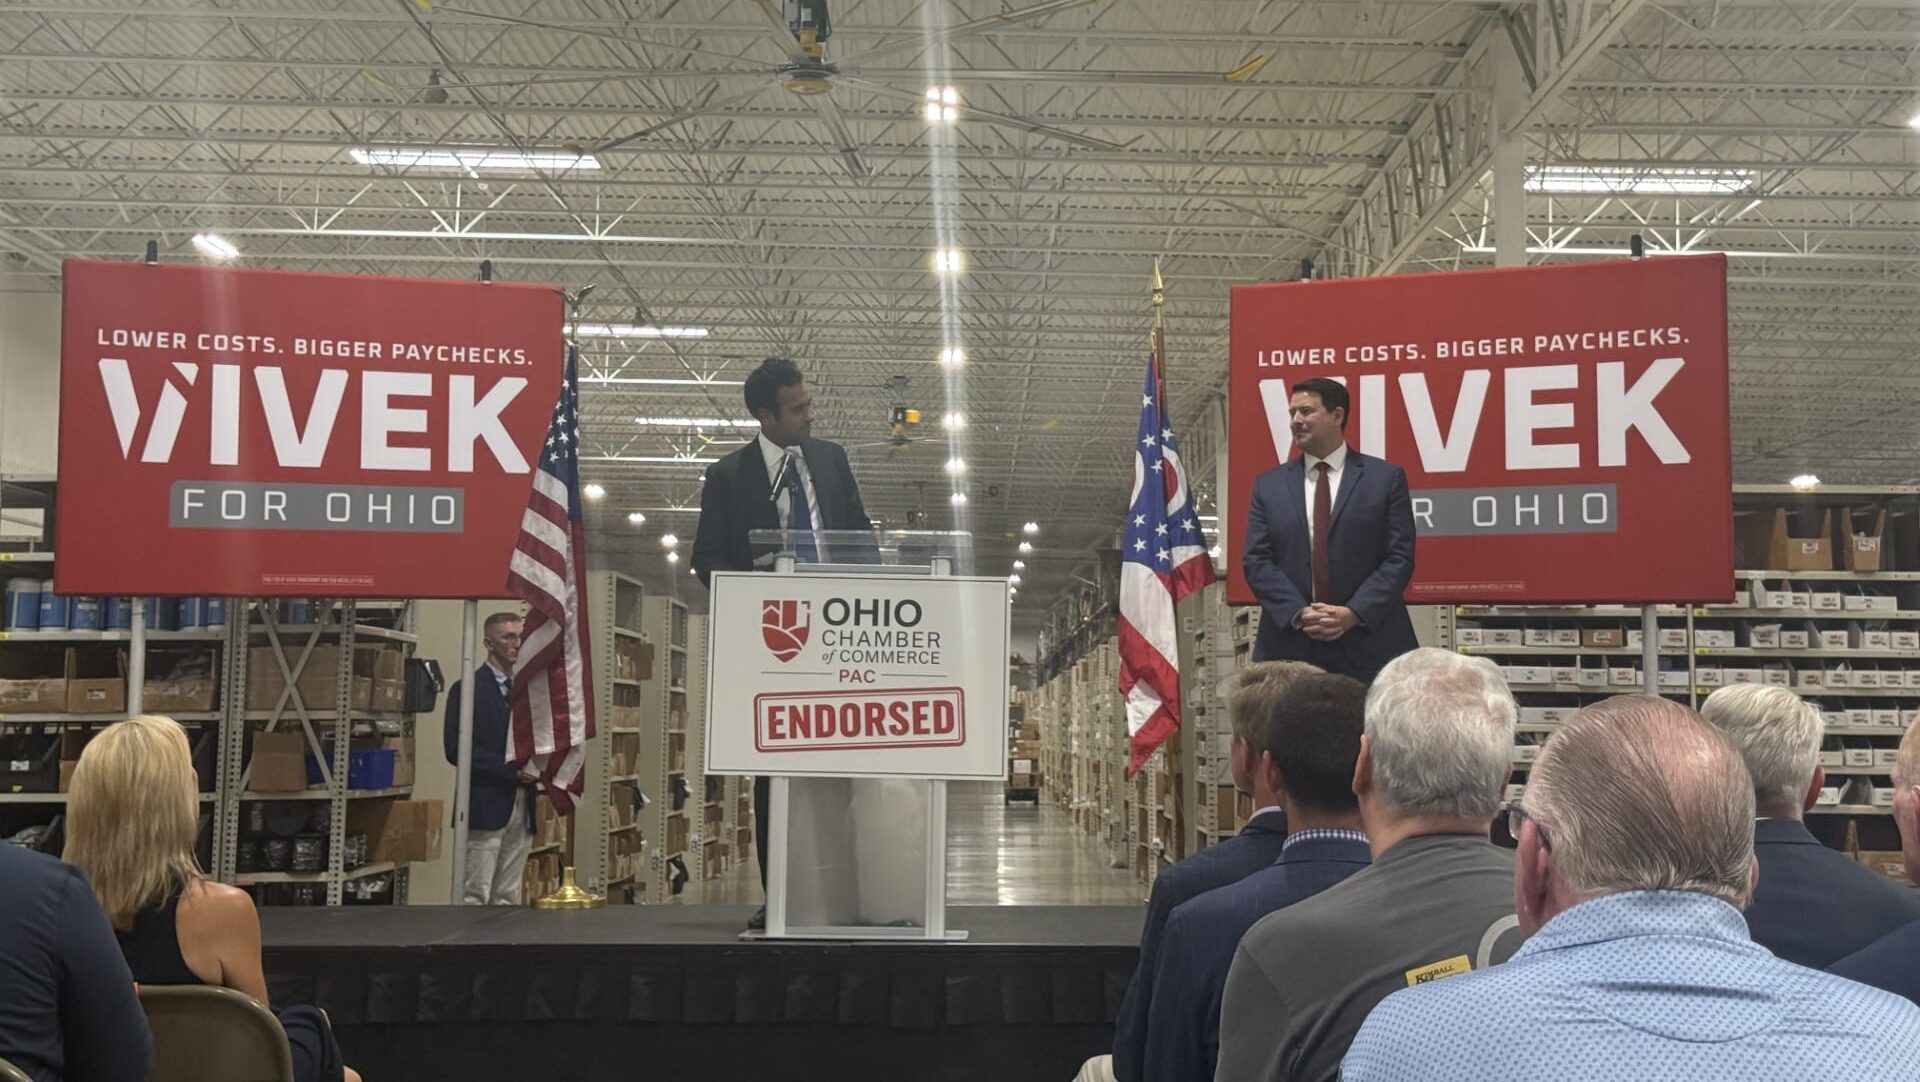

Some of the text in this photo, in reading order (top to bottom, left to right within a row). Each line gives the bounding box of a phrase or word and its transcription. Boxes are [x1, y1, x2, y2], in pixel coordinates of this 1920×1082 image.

[98, 328, 533, 366] LOWER COSTS. BIGGER PAYCHECKS.
[1258, 327, 1689, 367] LOWER COSTS. BIGGER PAYCHECKS.
[98, 358, 531, 474] VIVEK
[183, 488, 455, 525] FOR OHIO
[1472, 492, 1608, 527] OHIO
[822, 597, 923, 628] OHIO
[821, 629, 941, 649] CHAMBER
[821, 648, 941, 665] of COMMERCE
[838, 668, 876, 684] PAC
[767, 699, 954, 740] ENDORSED
